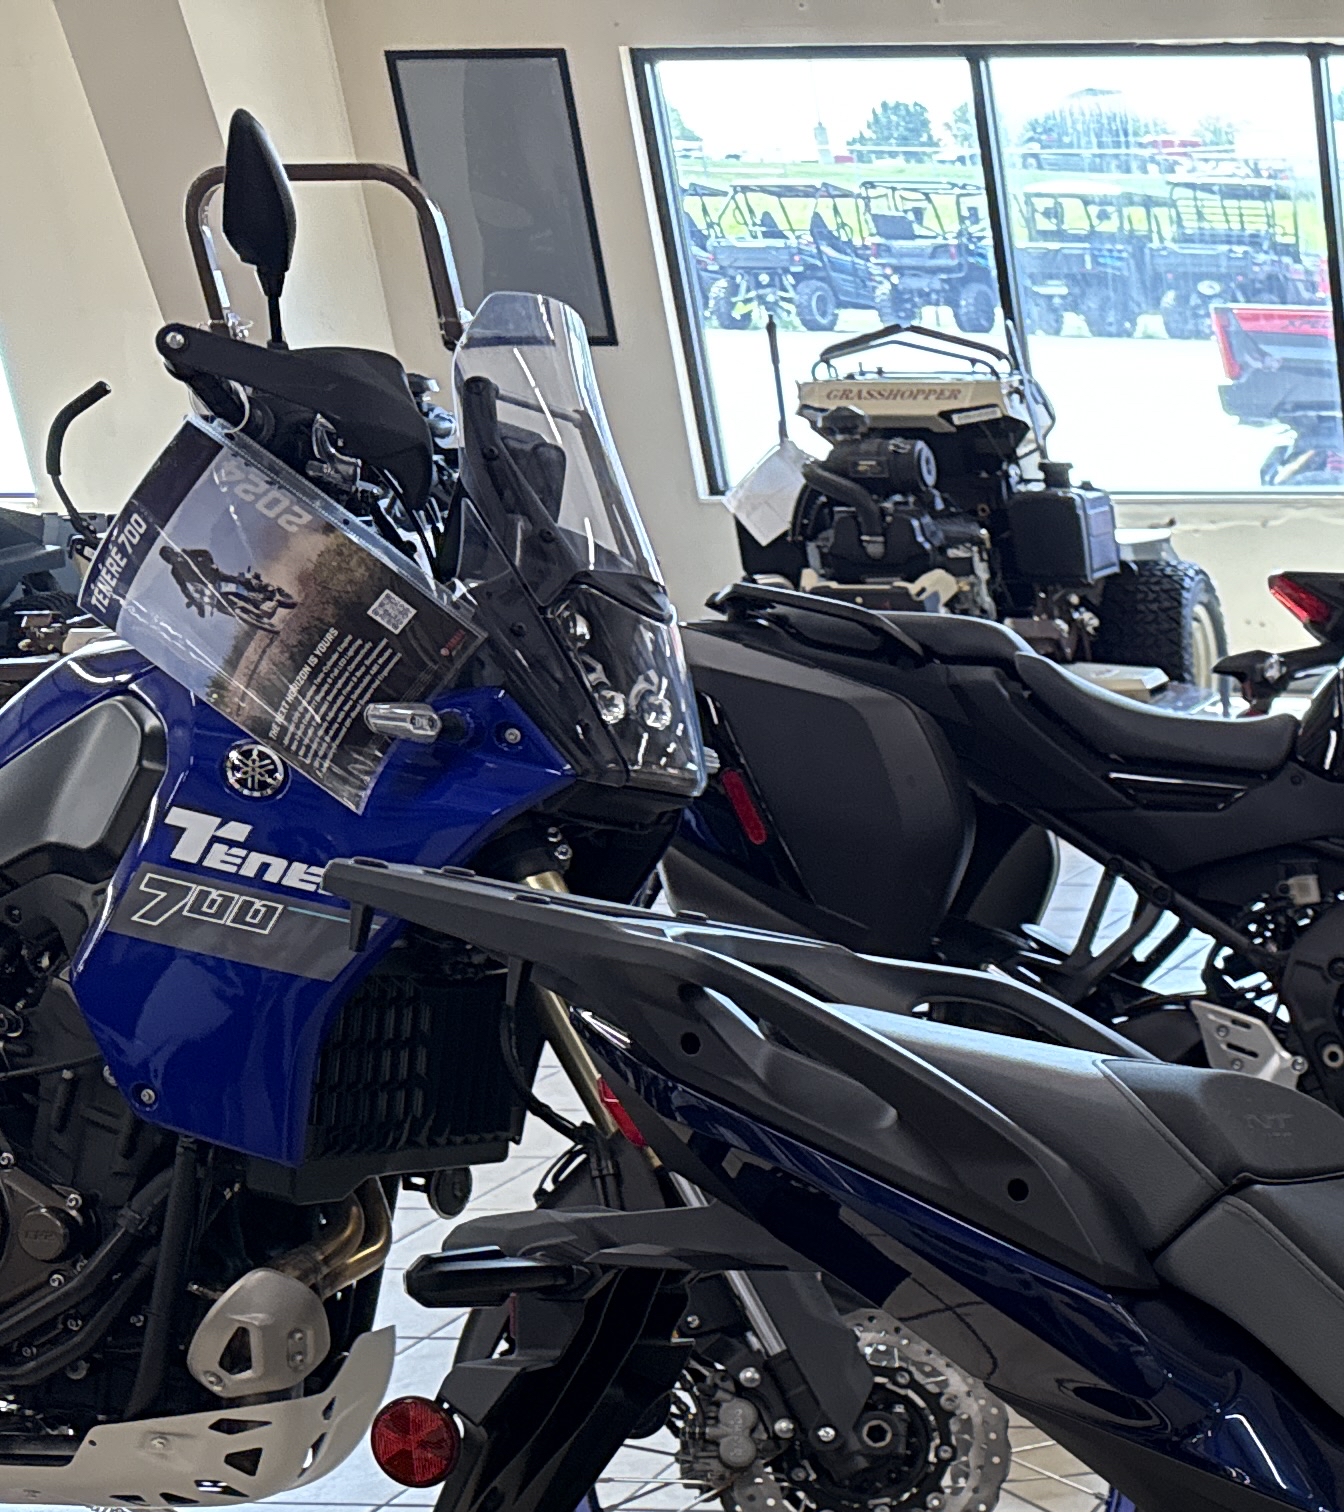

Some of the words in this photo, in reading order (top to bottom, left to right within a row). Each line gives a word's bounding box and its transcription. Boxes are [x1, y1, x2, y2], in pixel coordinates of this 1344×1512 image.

[826, 388, 962, 401] GRASSHOPPER
[117, 512, 148, 554] 700
[306, 653, 320, 669] IS
[313, 626, 340, 658] YOURS
[131, 872, 284, 935] 700
